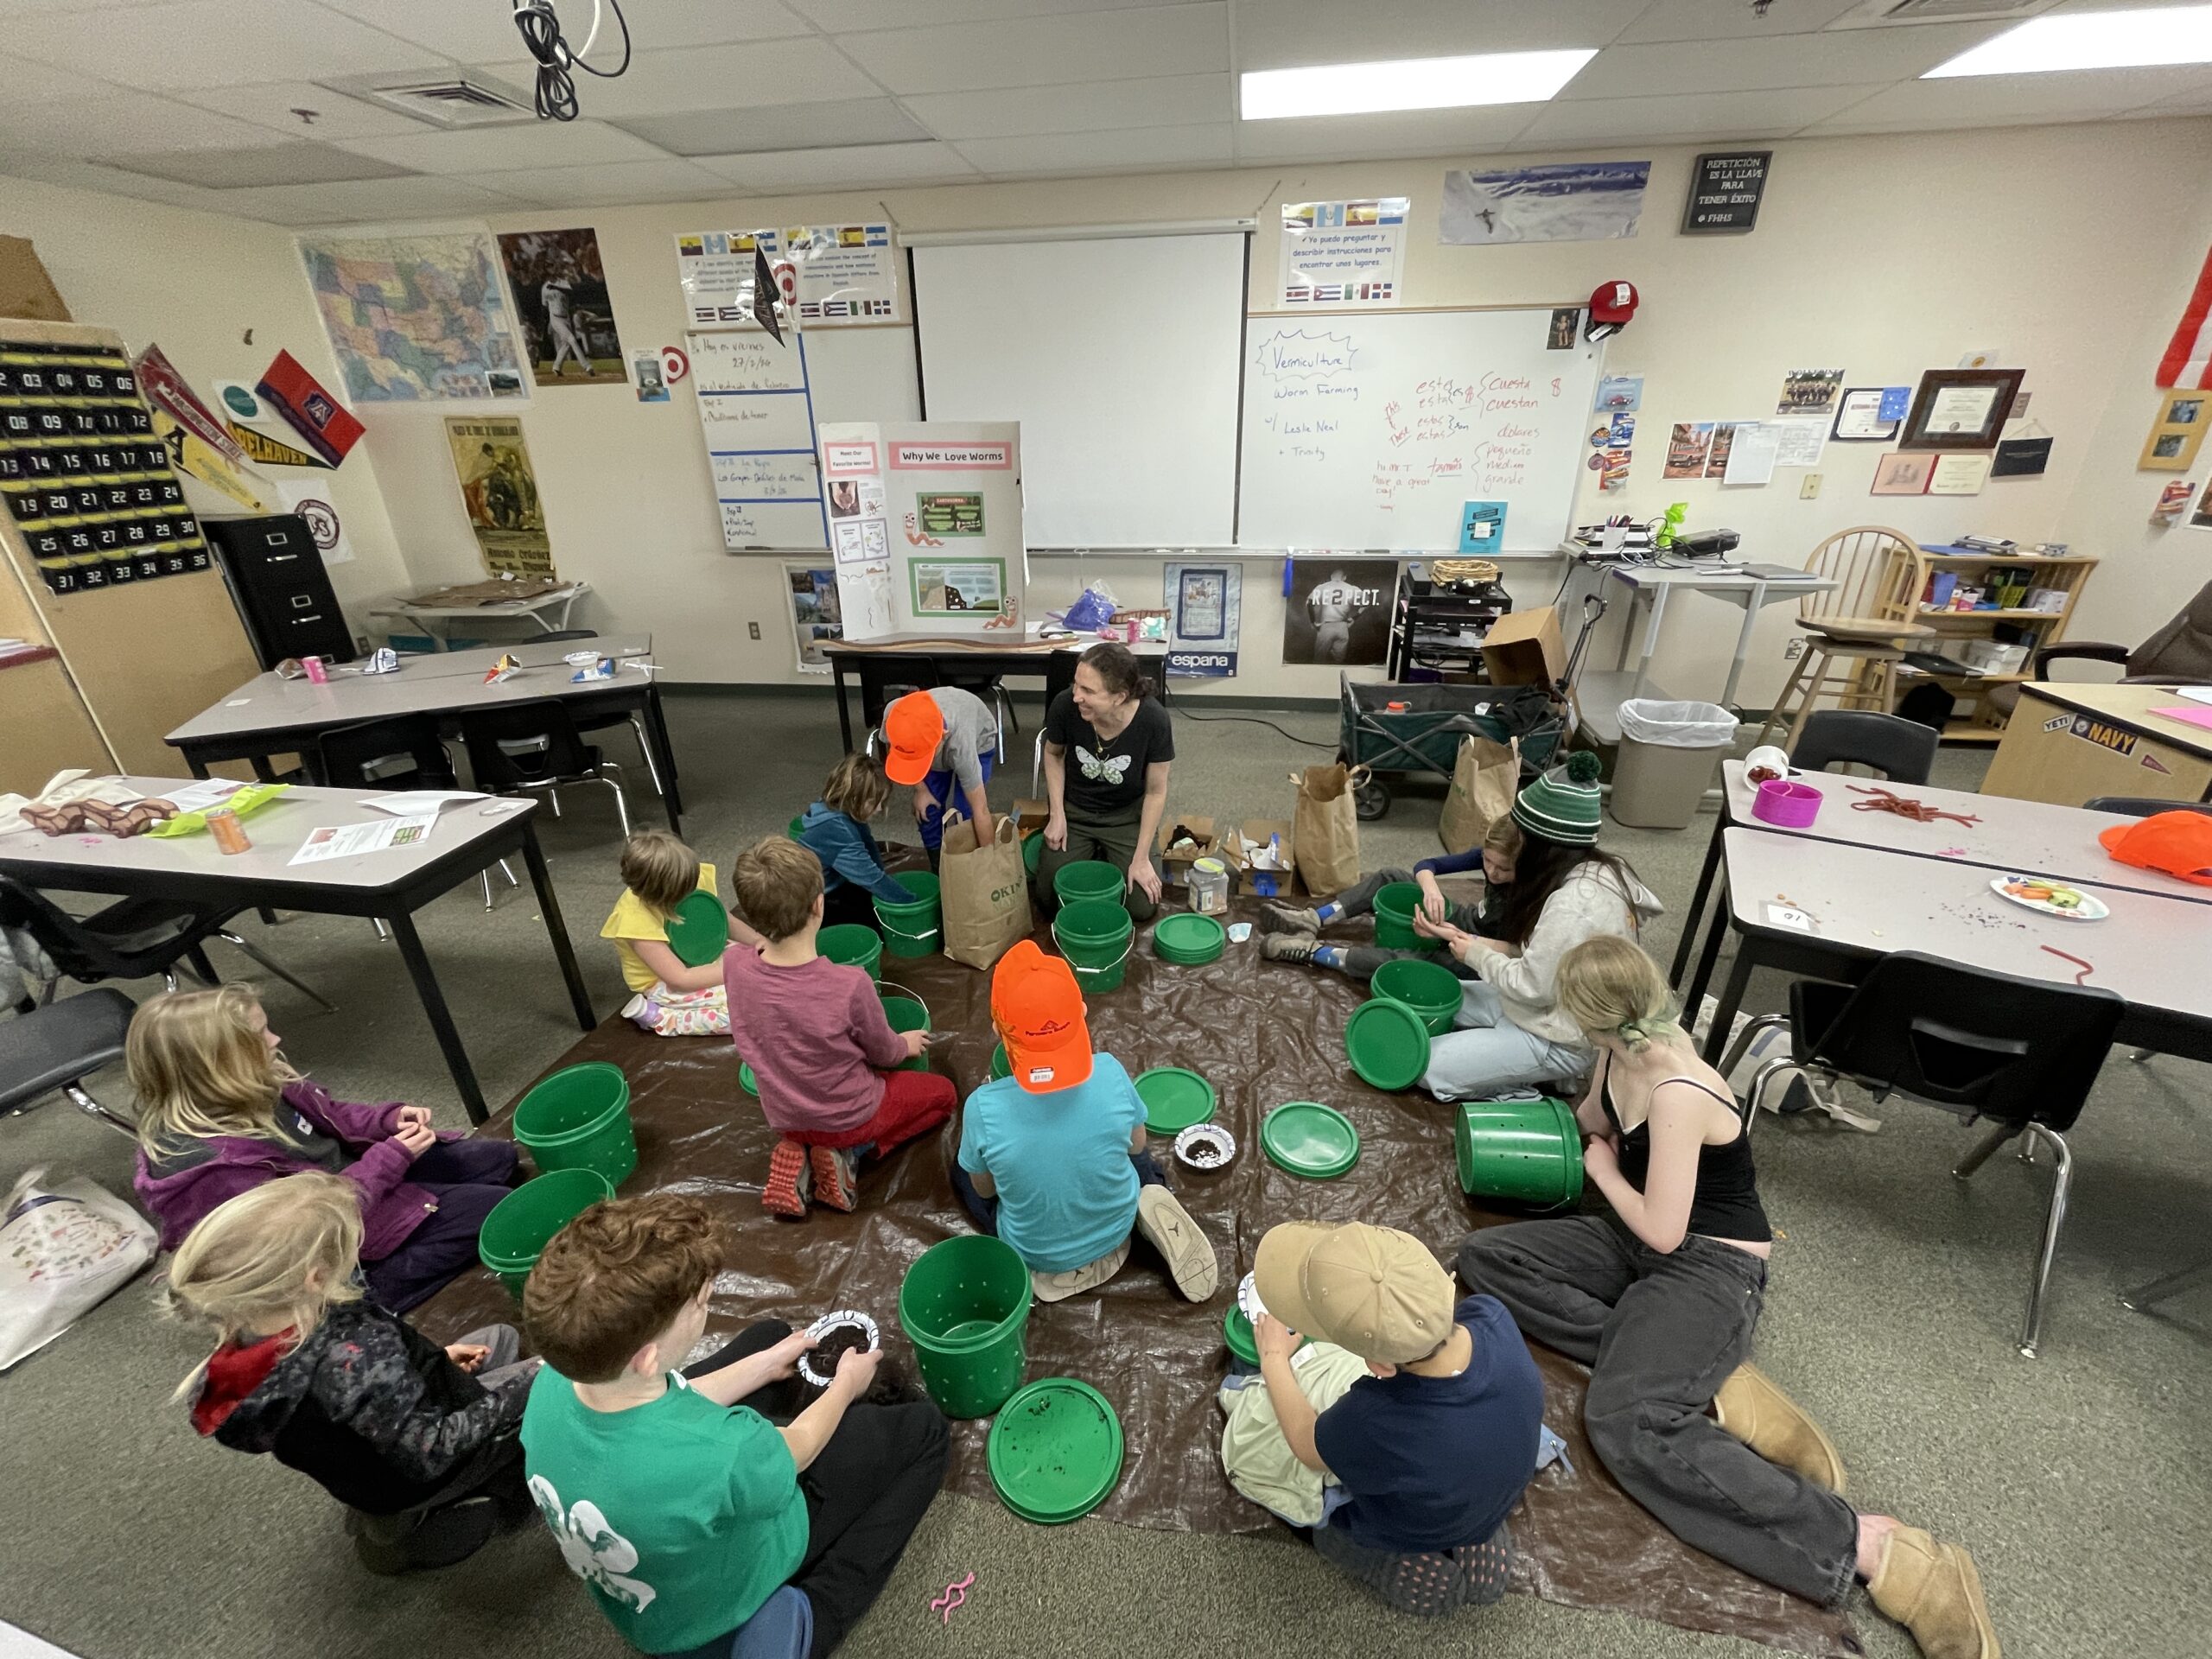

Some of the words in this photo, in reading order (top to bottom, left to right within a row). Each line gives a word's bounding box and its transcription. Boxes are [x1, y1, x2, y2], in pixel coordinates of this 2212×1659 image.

[1709, 170, 1719, 179] ES
[1721, 170, 1732, 179] LA
[1736, 169, 1764, 179] LLAVE
[1721, 181, 1744, 190] PARA
[1699, 195, 1727, 205] TENER
[1730, 192, 1757, 204] ÉXITO
[1320, 235, 1341, 245] puedo
[1343, 234, 1378, 245] preguntar
[1327, 246, 1372, 255] instrucciones
[1274, 346, 1343, 369] Vermiculture
[23, 374, 41, 387] 03
[56, 374, 73, 387] 04
[86, 375, 103, 388] 05
[117, 378, 133, 390] 06
[1274, 386, 1308, 398] Worm
[1317, 385, 1358, 401] Farming
[9, 416, 29, 429] 08
[43, 416, 61, 429] 09
[78, 416, 93, 429] 10
[104, 415, 120, 429] 11
[132, 415, 147, 427] 12
[1284, 422, 1312, 434] Leslie
[1317, 420, 1338, 432] Neal
[238, 429, 308, 463] BELHAVEN
[1291, 446, 1325, 461] Trinity
[1, 460, 18, 474] 13
[31, 456, 51, 470] 14
[63, 454, 80, 468] 15
[94, 454, 111, 467] 16
[121, 452, 136, 465] 17
[149, 451, 164, 464] 18
[903, 452, 923, 462] Why
[925, 452, 940, 461] We
[944, 452, 967, 461] Love
[969, 452, 1003, 461] Worms
[19, 499, 38, 512] 19
[50, 496, 68, 509] 20
[81, 493, 99, 505] 21
[111, 491, 127, 504] 22
[138, 488, 152, 501] 23
[164, 486, 178, 499] 24
[41, 537, 57, 551] 25
[72, 534, 89, 547] 26
[102, 531, 116, 543] 27
[130, 527, 144, 539] 28
[156, 524, 170, 537] 29
[181, 521, 194, 533] 30
[59, 575, 74, 588] 31
[86, 570, 103, 583] 32
[117, 567, 130, 579] 33
[143, 563, 156, 575] 34
[171, 558, 183, 570] 35
[194, 555, 206, 566] 36
[2044, 716, 2068, 729] YETI
[2088, 722, 2135, 753] NAVY
